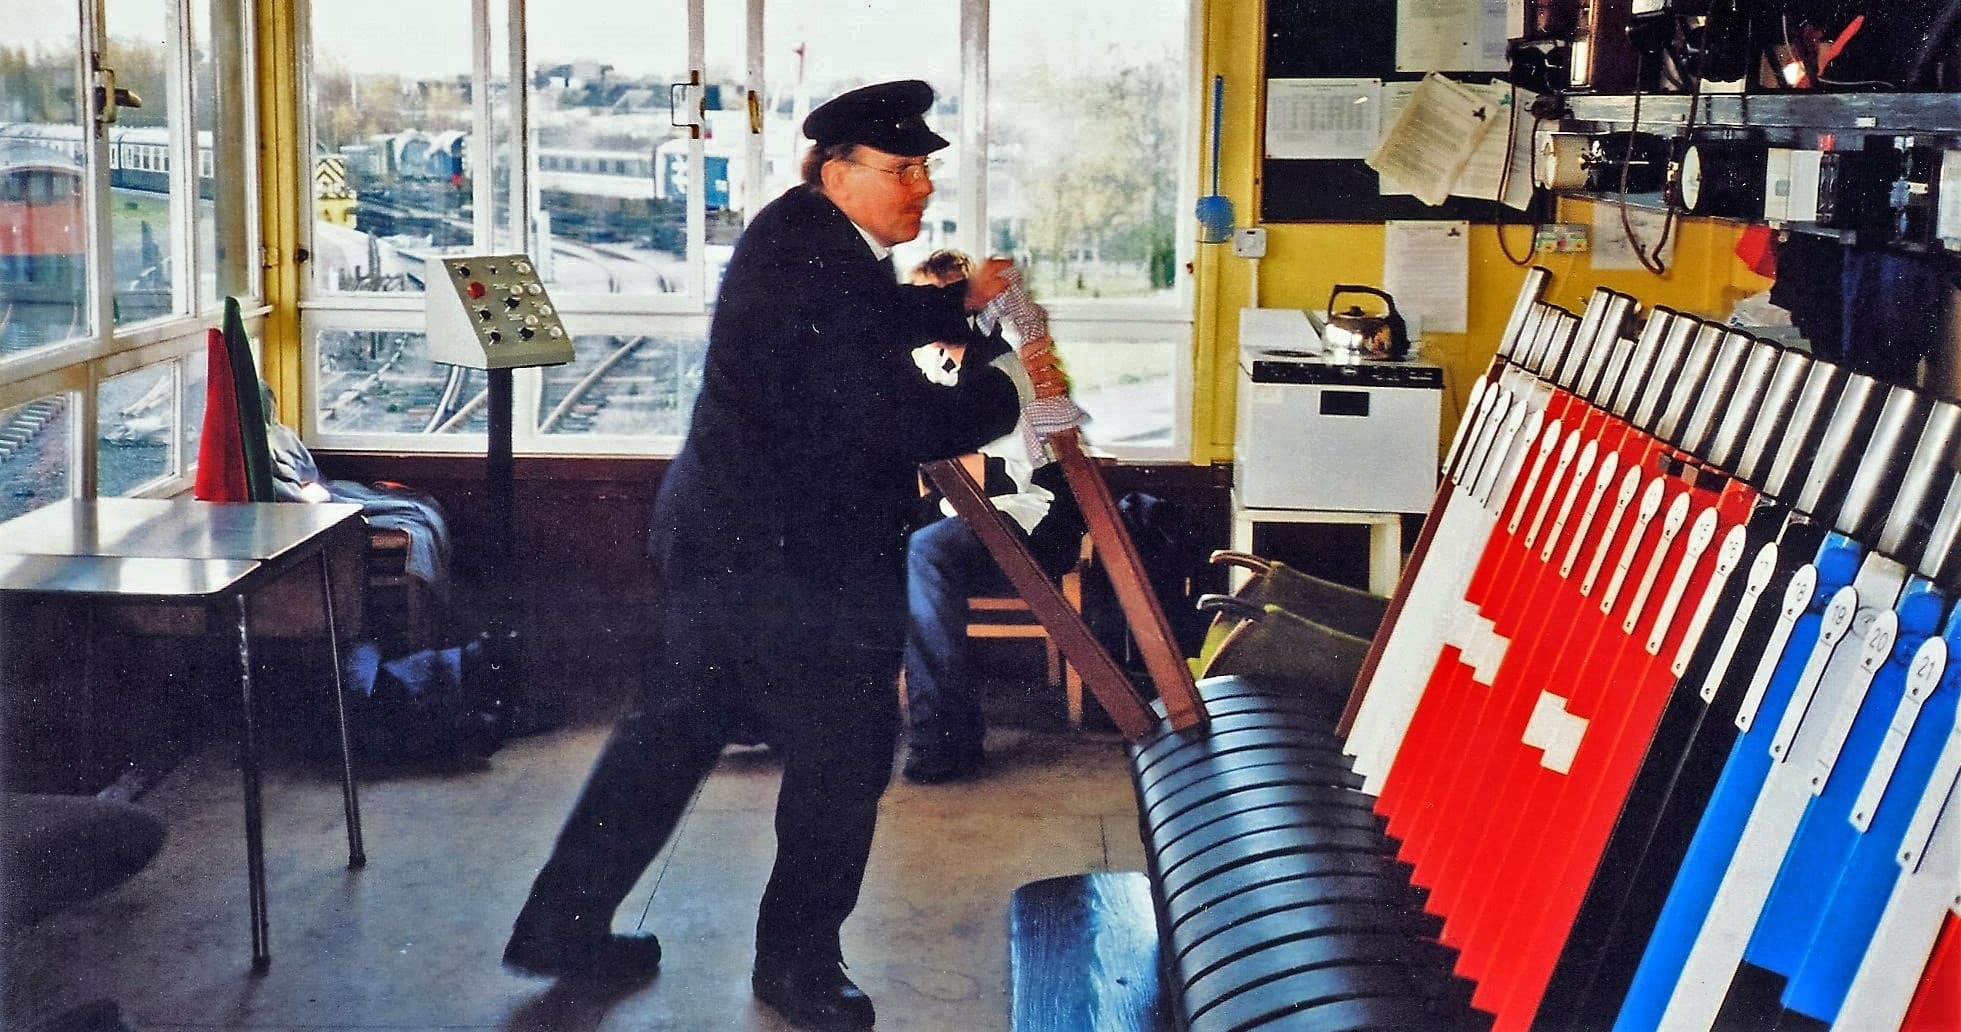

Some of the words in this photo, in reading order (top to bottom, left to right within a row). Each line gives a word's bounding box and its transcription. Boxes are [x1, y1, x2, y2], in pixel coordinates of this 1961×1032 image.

[1832, 604, 1847, 625] 19
[1869, 627, 1889, 653] 20
[1917, 656, 1936, 681] 21
